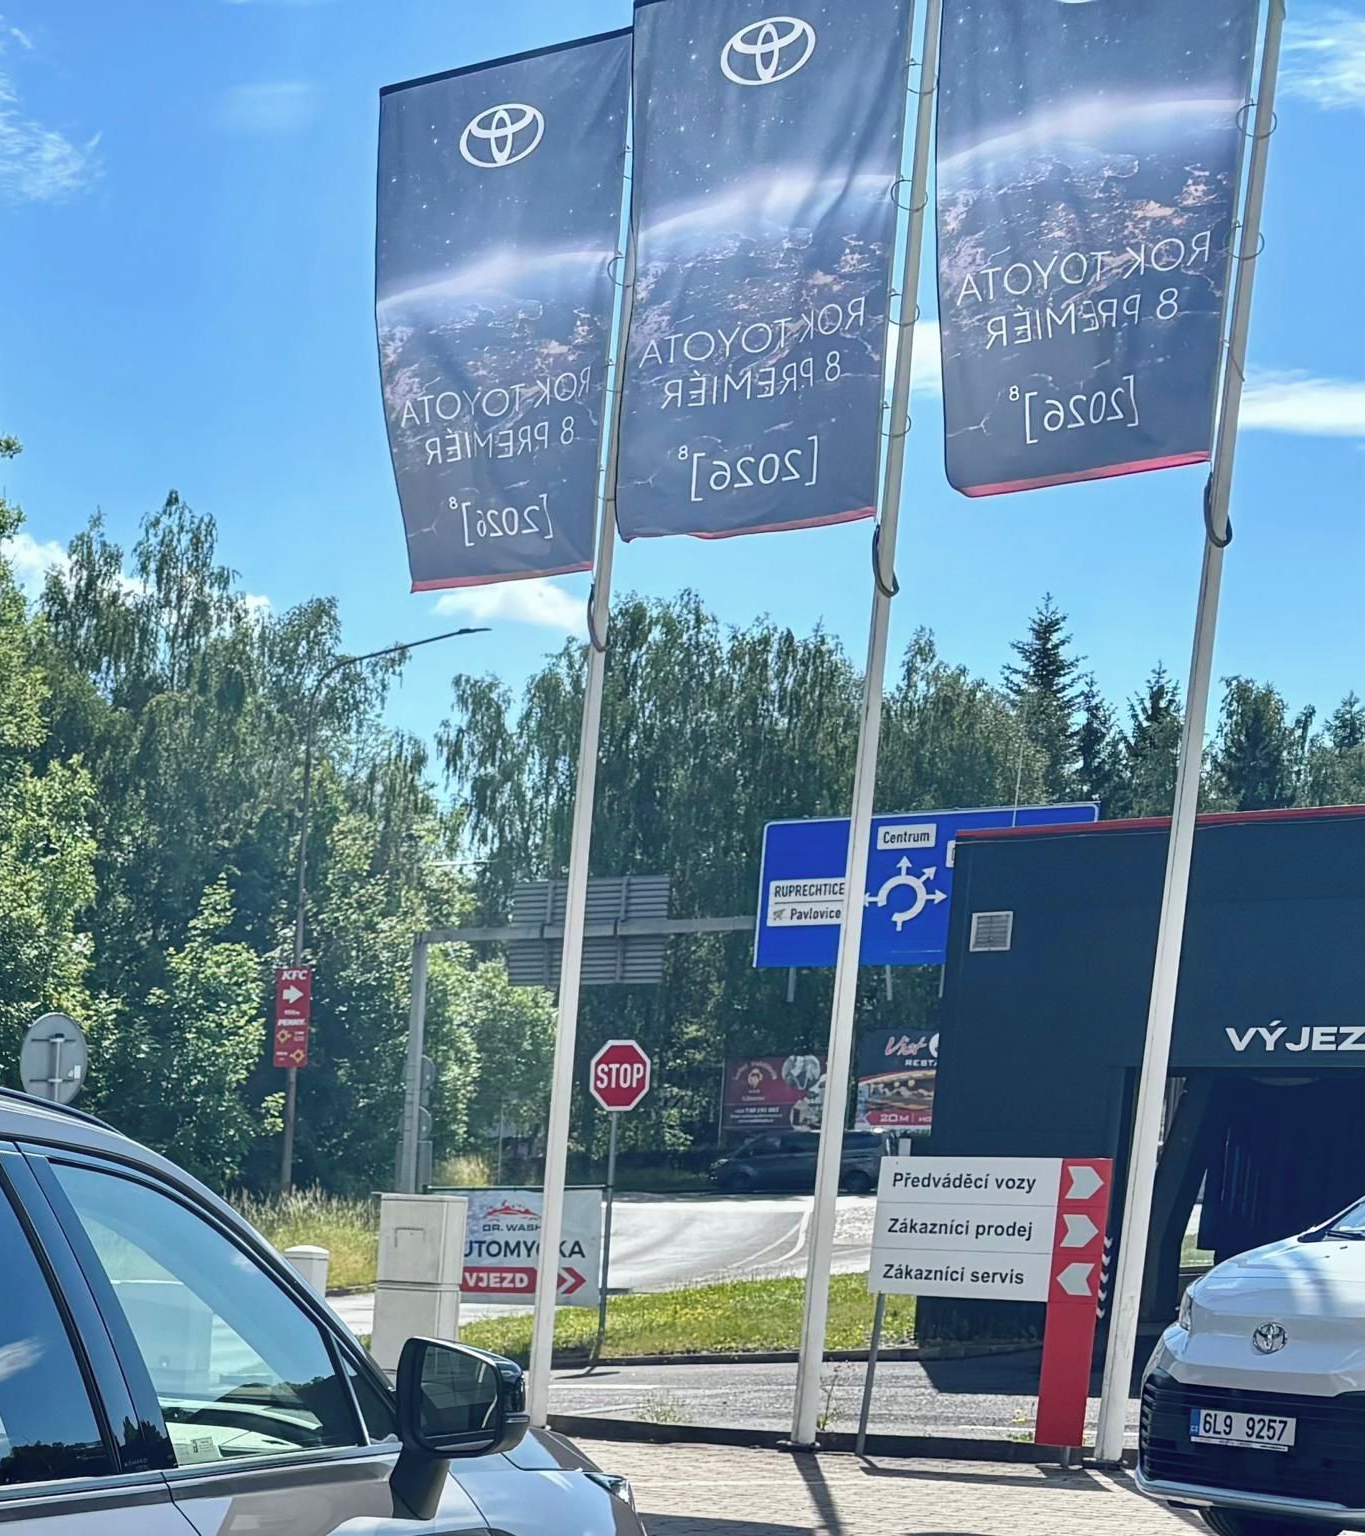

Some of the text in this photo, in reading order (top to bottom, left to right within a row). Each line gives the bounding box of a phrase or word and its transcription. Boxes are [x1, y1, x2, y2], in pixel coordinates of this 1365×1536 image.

[883, 831, 930, 844] Centrum
[774, 882, 845, 898] RUPRECHTICE
[790, 908, 841, 921] Pavlovice
[281, 970, 308, 980] KFC
[597, 1064, 643, 1088] STOP
[892, 1172, 1036, 1194] Předváděcí vozy
[887, 1218, 1033, 1241] Zákazníci prodej
[464, 1272, 529, 1288] VJEZD
[883, 1264, 1024, 1284] Zákazníci servis
[1203, 1413, 1288, 1441] 6L9 9257
